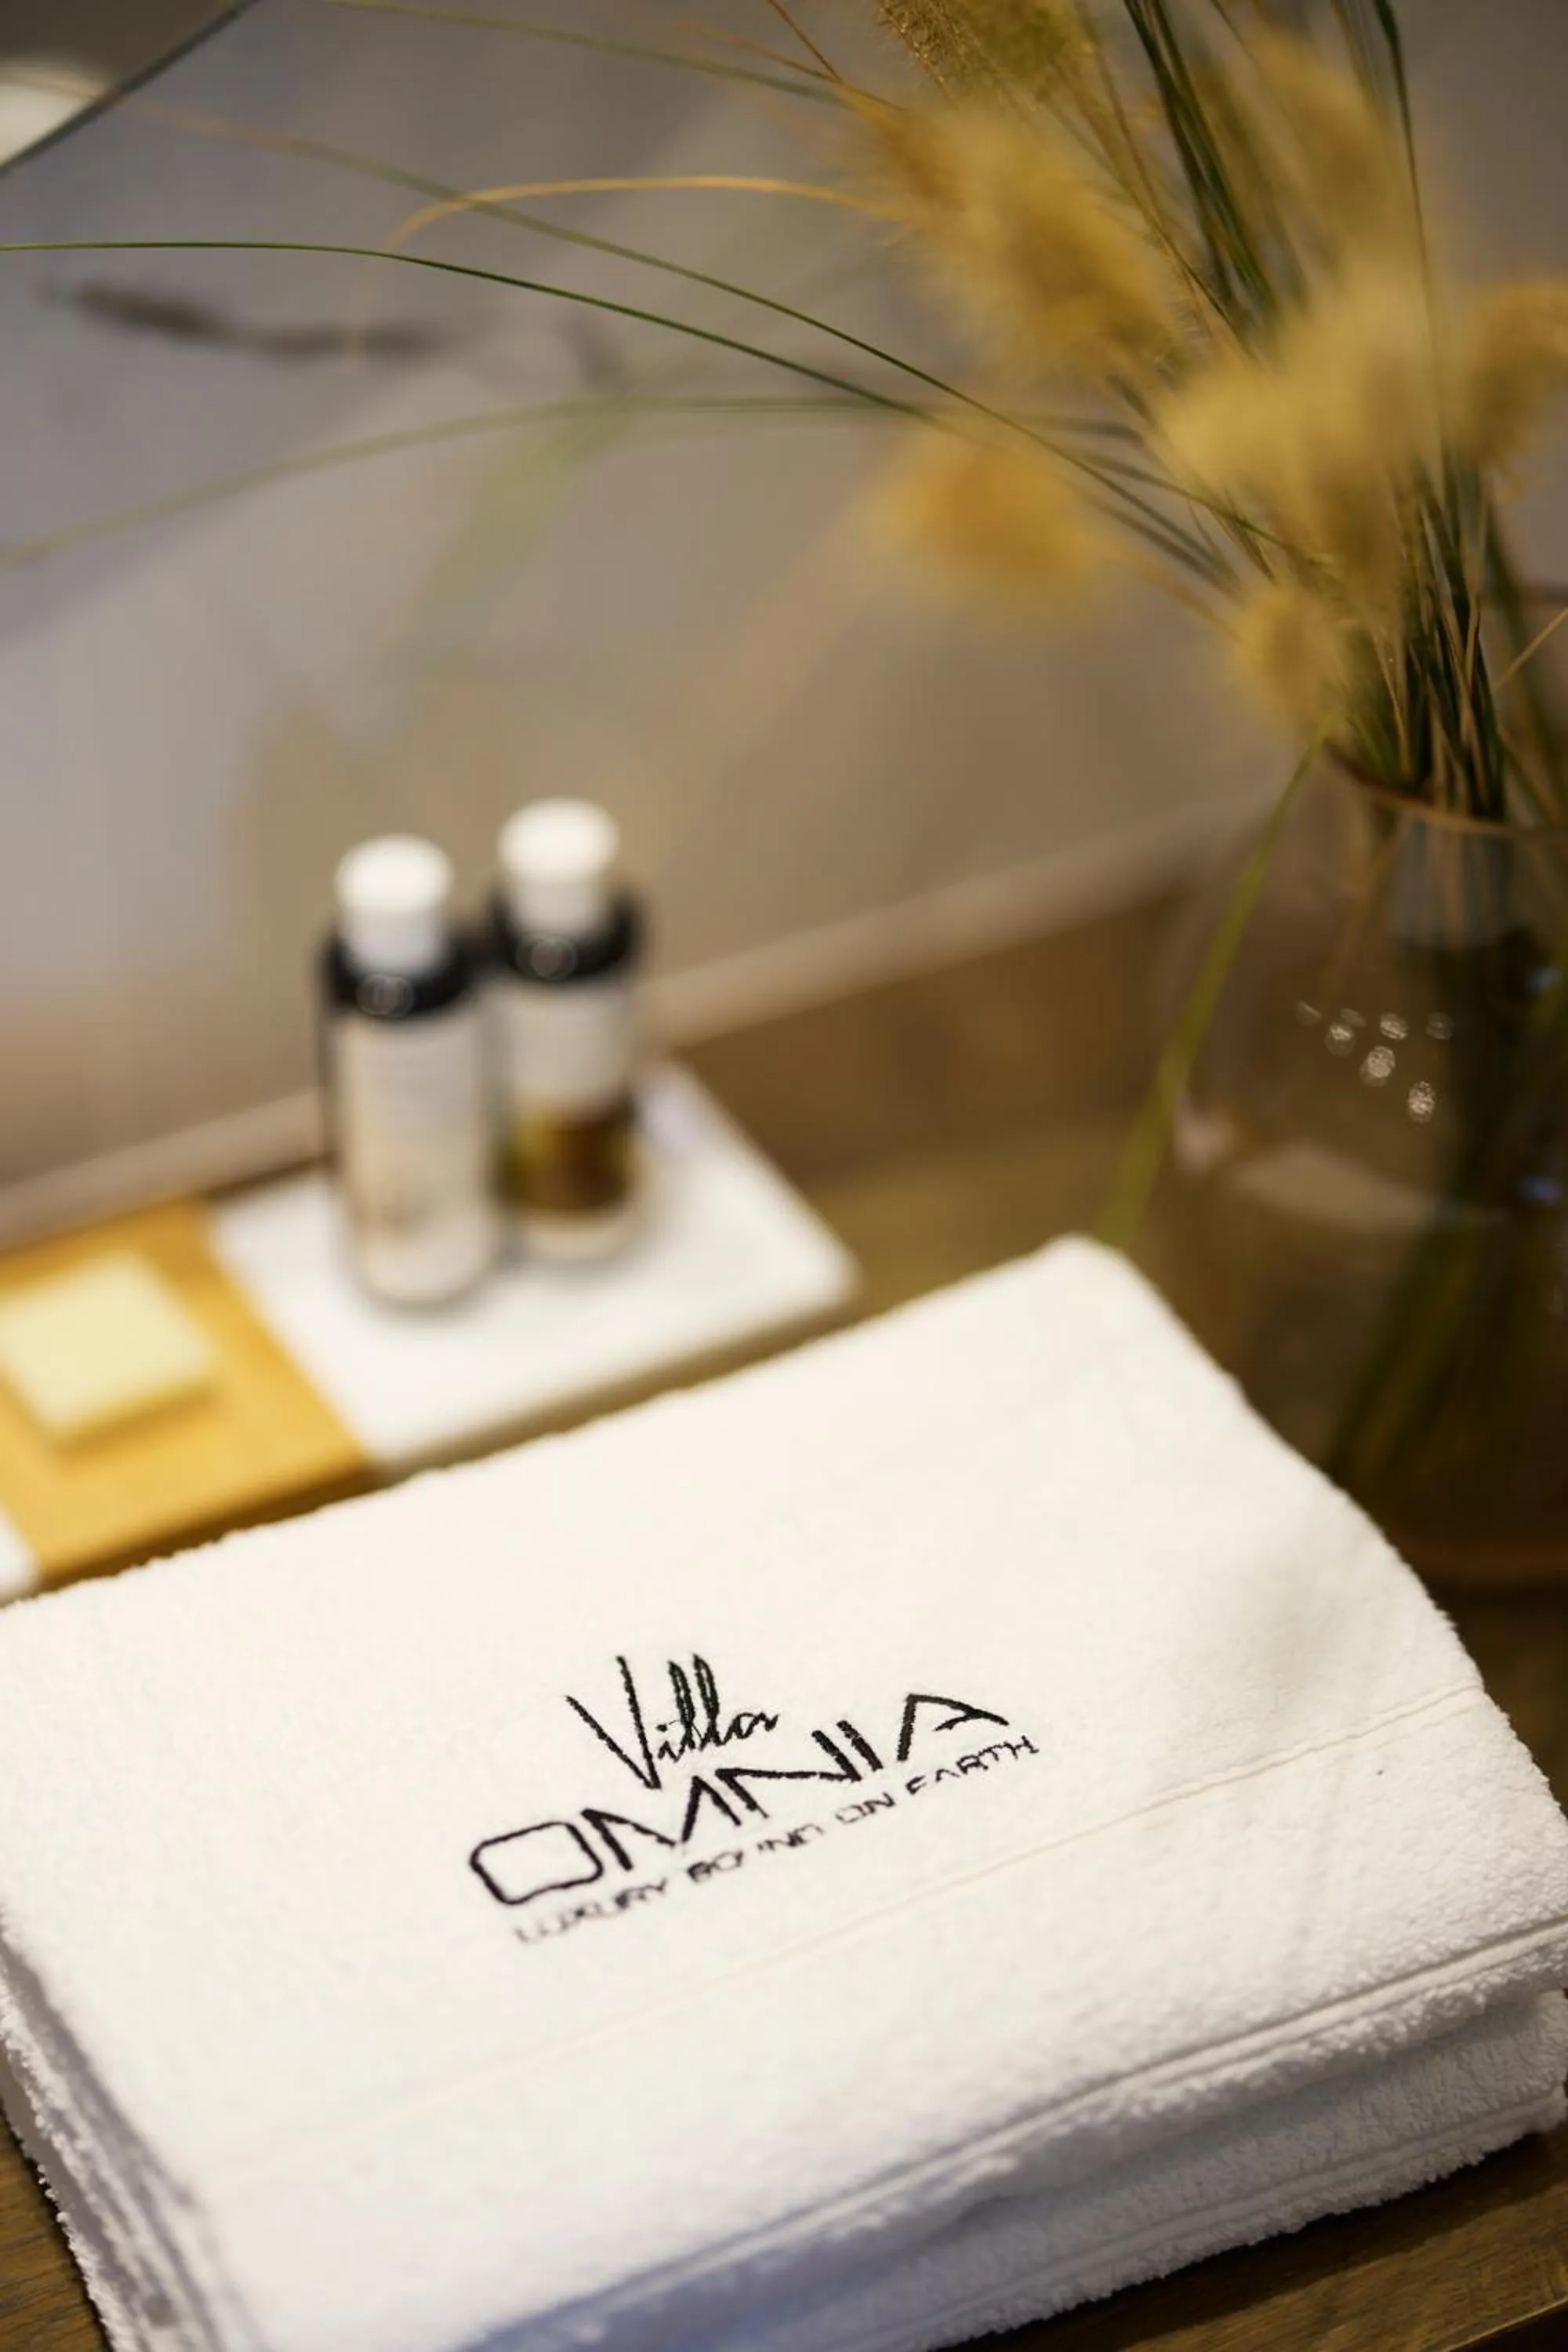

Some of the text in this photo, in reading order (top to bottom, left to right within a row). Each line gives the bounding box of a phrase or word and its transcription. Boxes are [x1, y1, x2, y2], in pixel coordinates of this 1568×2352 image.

[470, 1693, 1009, 1904] OMNIA
[565, 1653, 779, 1789] Villa
[514, 1878, 667, 1943] LUXURY
[835, 1791, 895, 1824] ON
[906, 1735, 1040, 1794] EARTH
